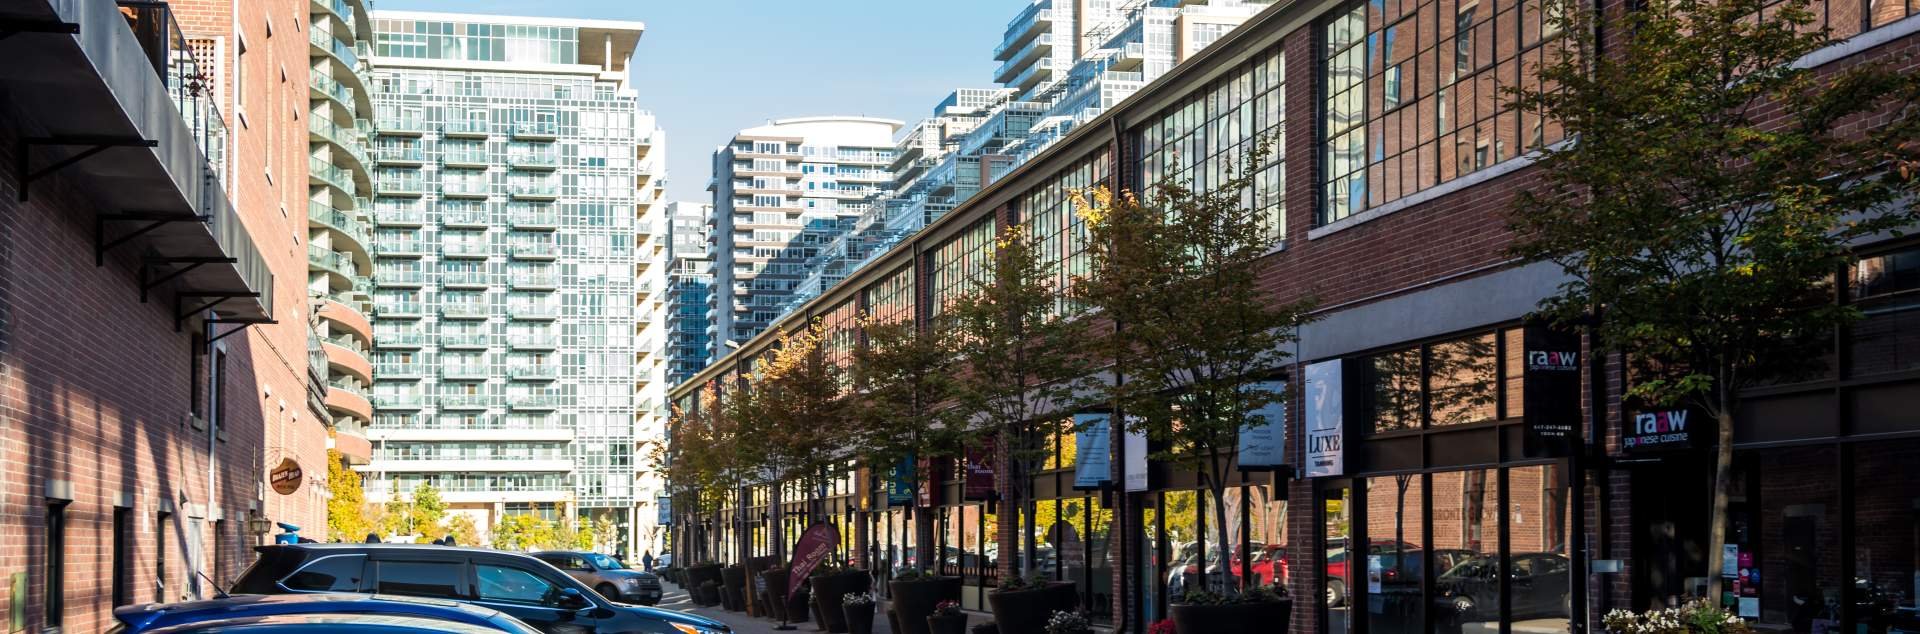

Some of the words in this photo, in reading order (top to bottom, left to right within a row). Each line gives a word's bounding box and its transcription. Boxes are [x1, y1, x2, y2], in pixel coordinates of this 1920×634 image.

[1528, 350, 1577, 366] raaw
[1635, 409, 1688, 434] raaw
[1308, 434, 1340, 454] LUXE
[1623, 434, 1659, 448] japanese
[1660, 432, 1688, 443] cuisine
[792, 560, 808, 574] Thai
[806, 543, 826, 560] Room
